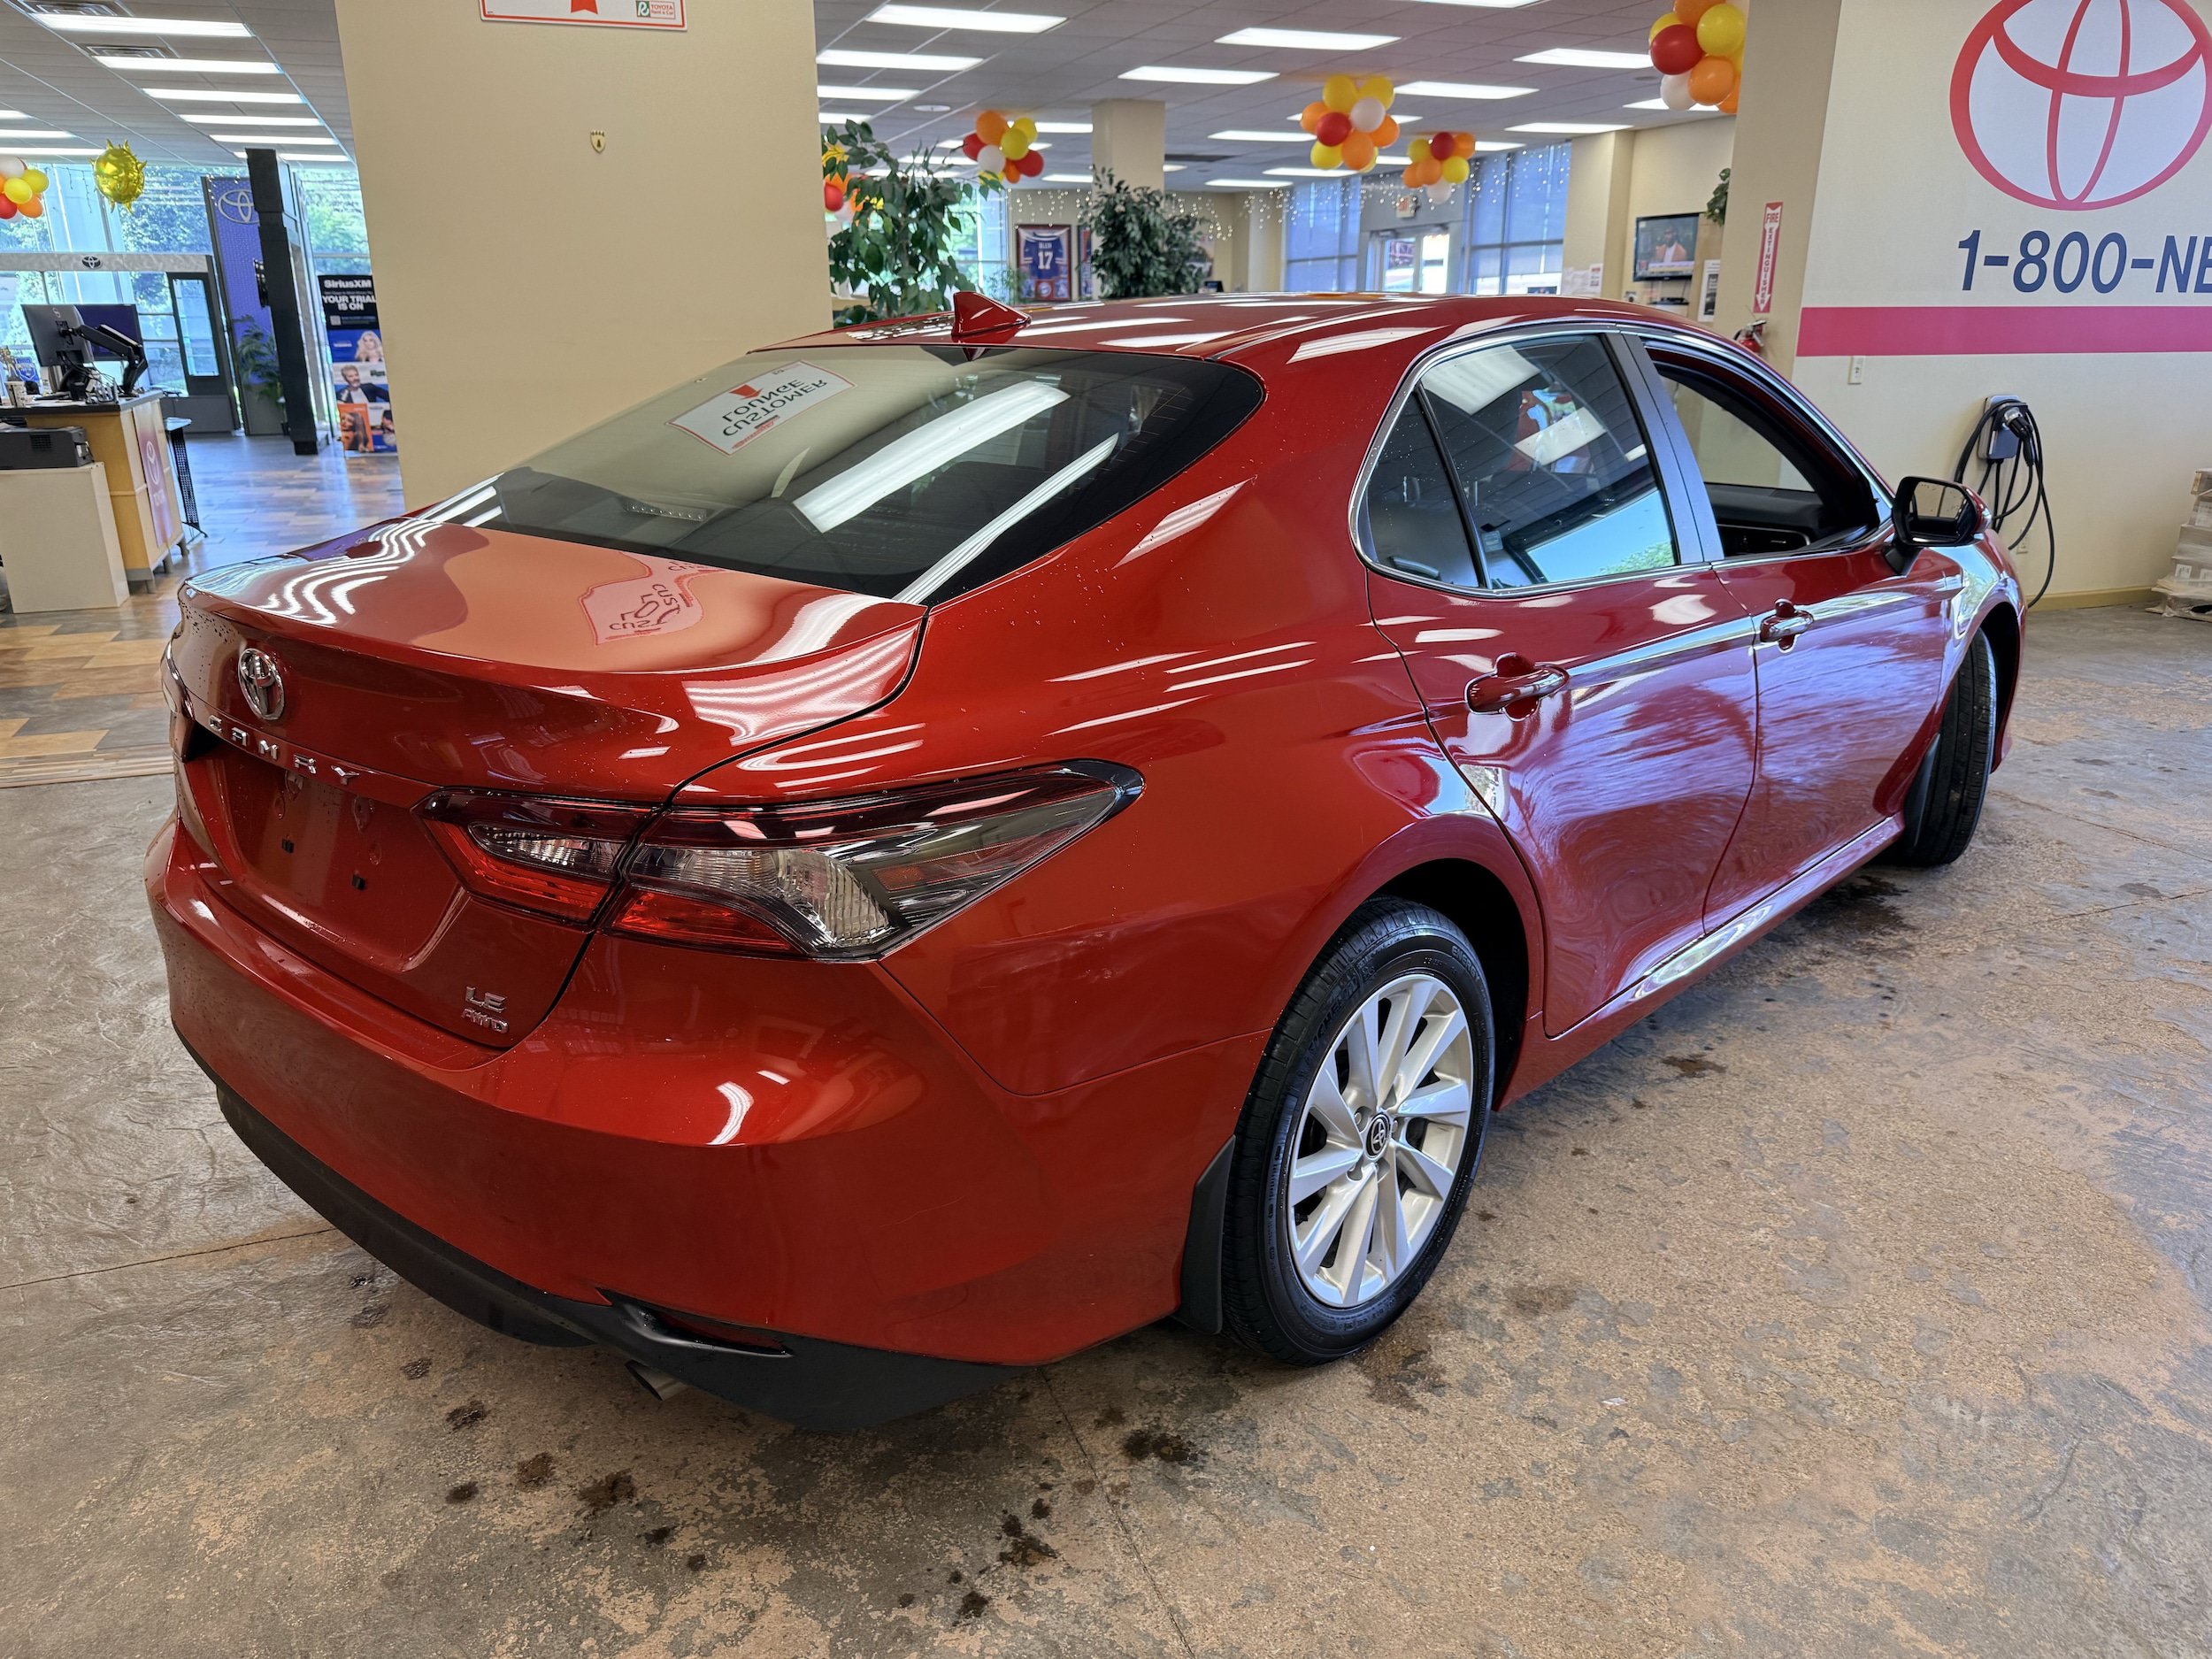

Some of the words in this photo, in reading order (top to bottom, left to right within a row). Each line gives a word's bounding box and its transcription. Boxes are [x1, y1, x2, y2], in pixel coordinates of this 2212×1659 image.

[1766, 212, 1779, 223] FIRE
[1038, 251, 1054, 270] 17
[1760, 227, 1774, 304] EXTINGUISHER
[324, 279, 372, 288] SiriusXM
[322, 295, 349, 303] YOUR
[209, 715, 360, 786] CAMRY
[465, 986, 507, 1014] LE
[461, 1008, 509, 1033] AWD
